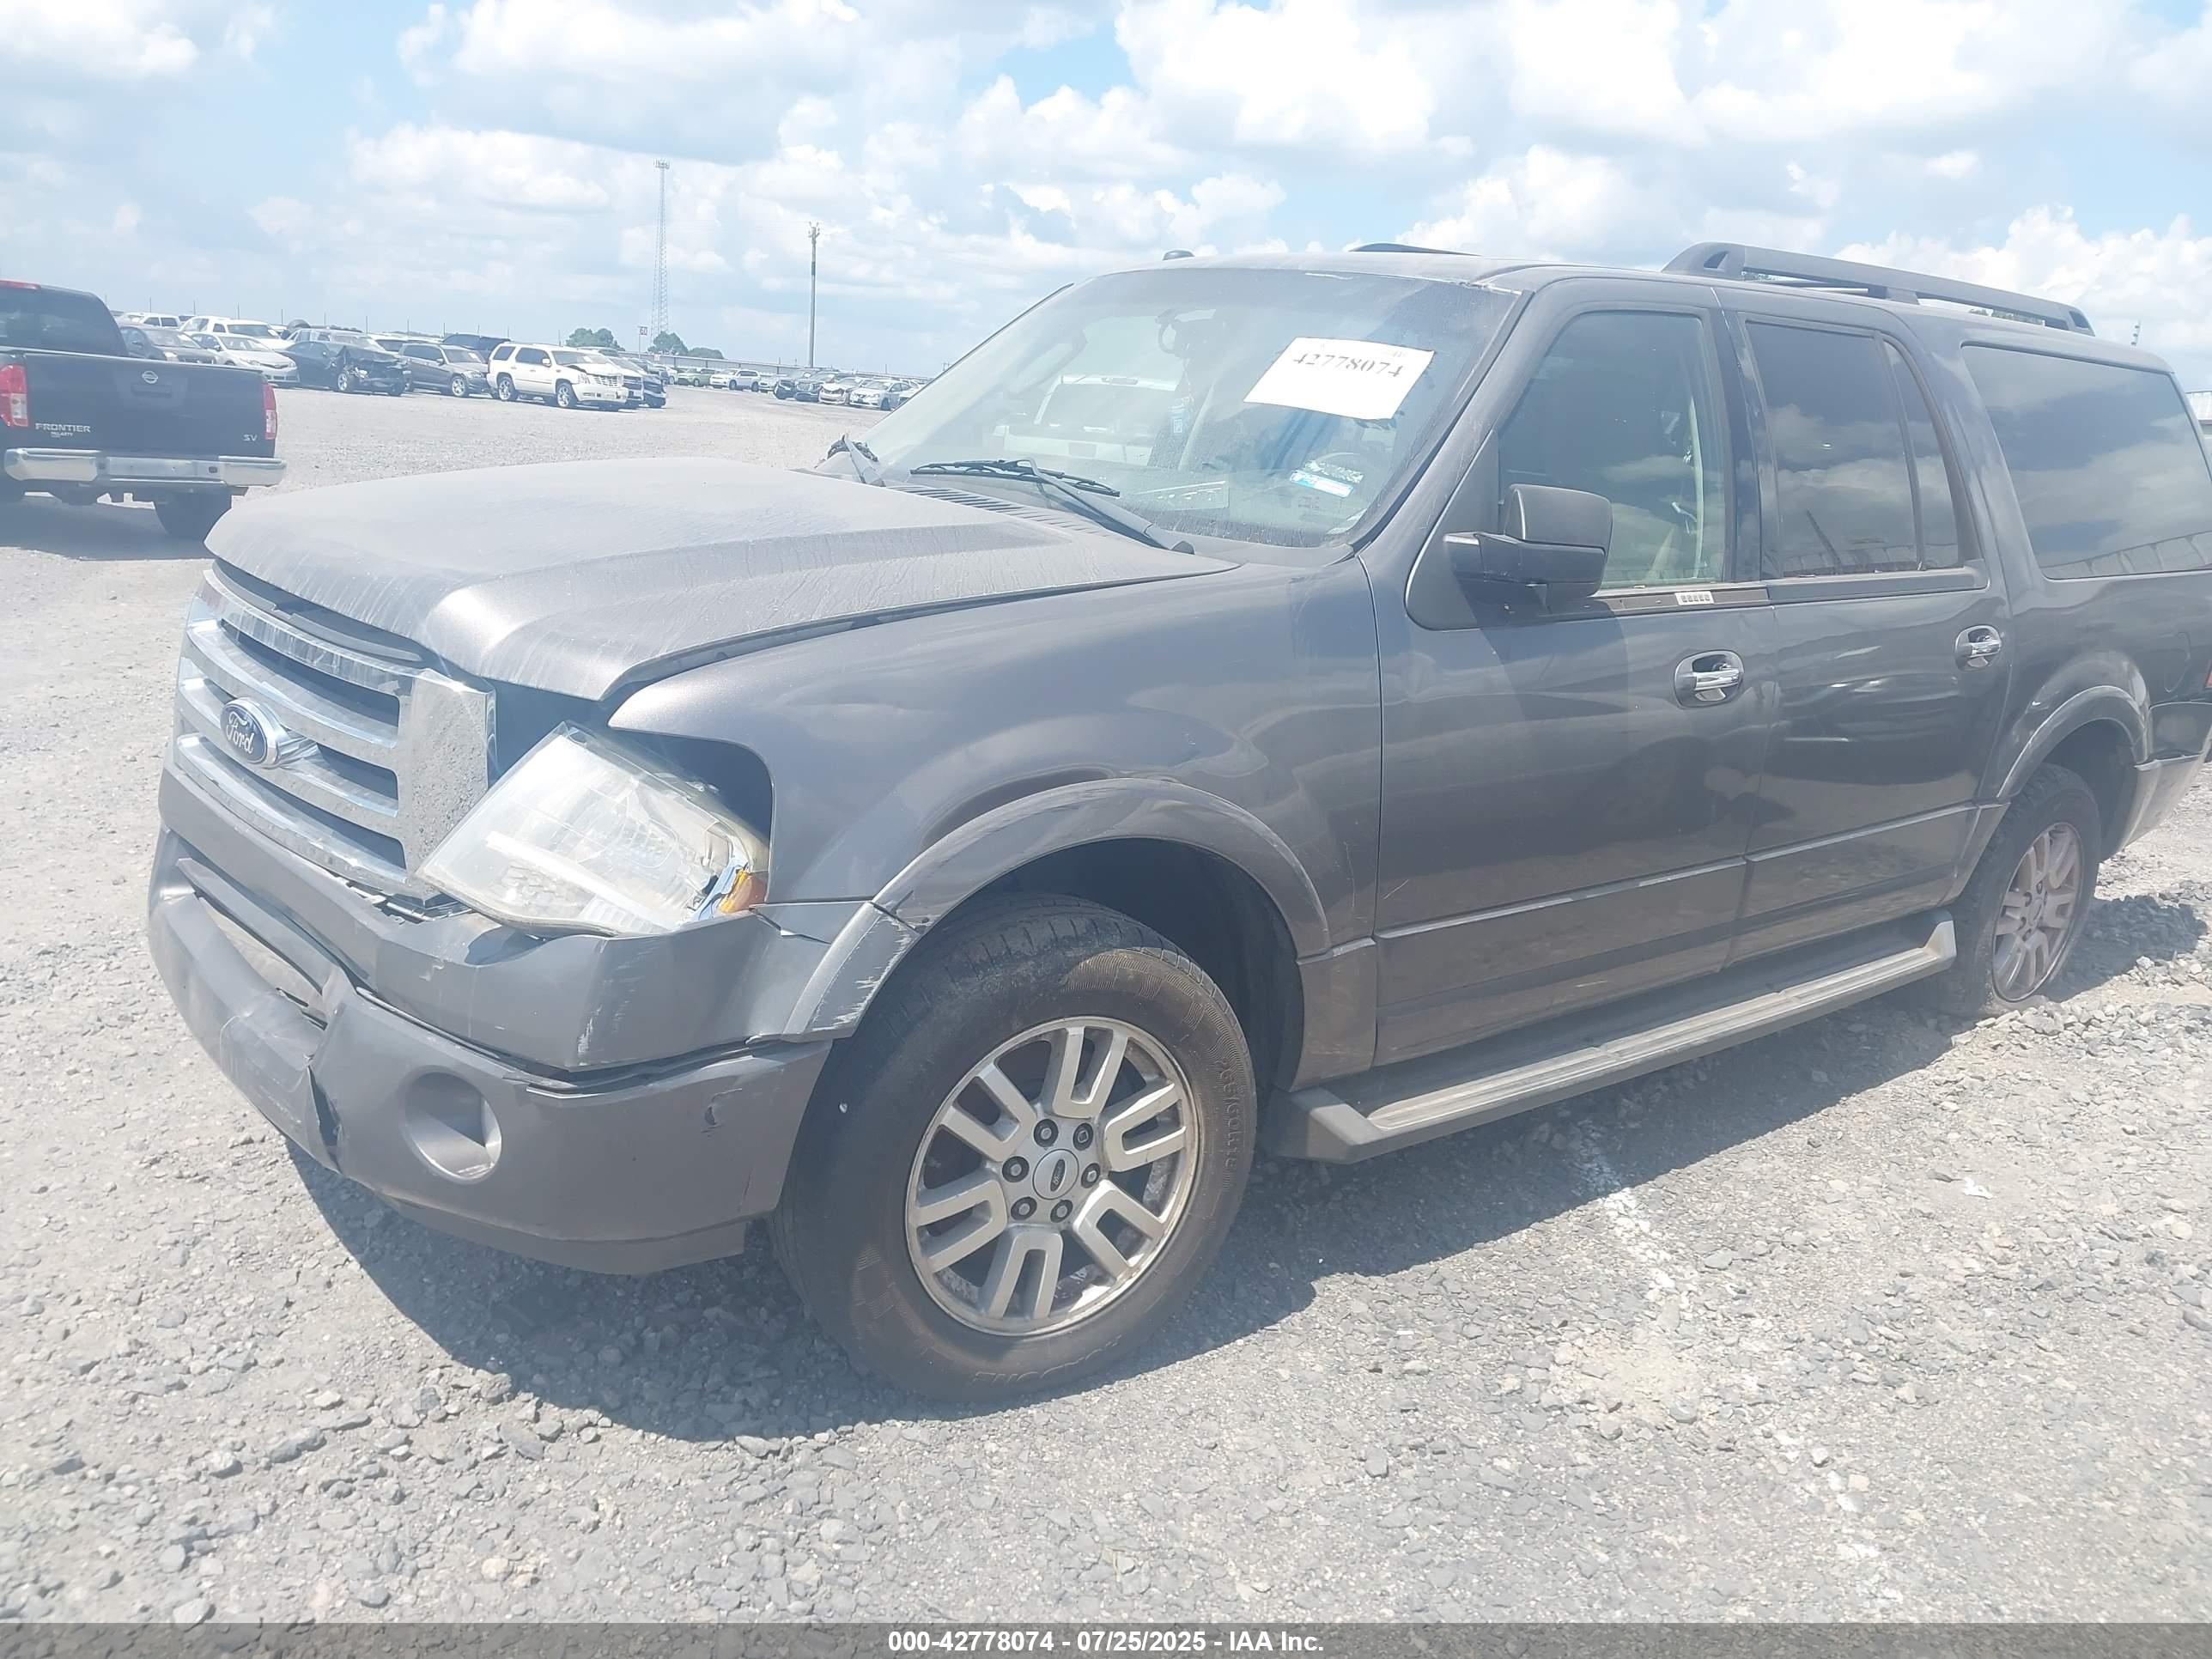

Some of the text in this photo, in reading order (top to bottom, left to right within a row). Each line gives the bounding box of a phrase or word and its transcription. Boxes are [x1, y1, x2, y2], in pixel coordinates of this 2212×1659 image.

[1293, 352, 1404, 378] 42778074
[35, 422, 91, 433] FRONTIER
[226, 711, 255, 754] Ford
